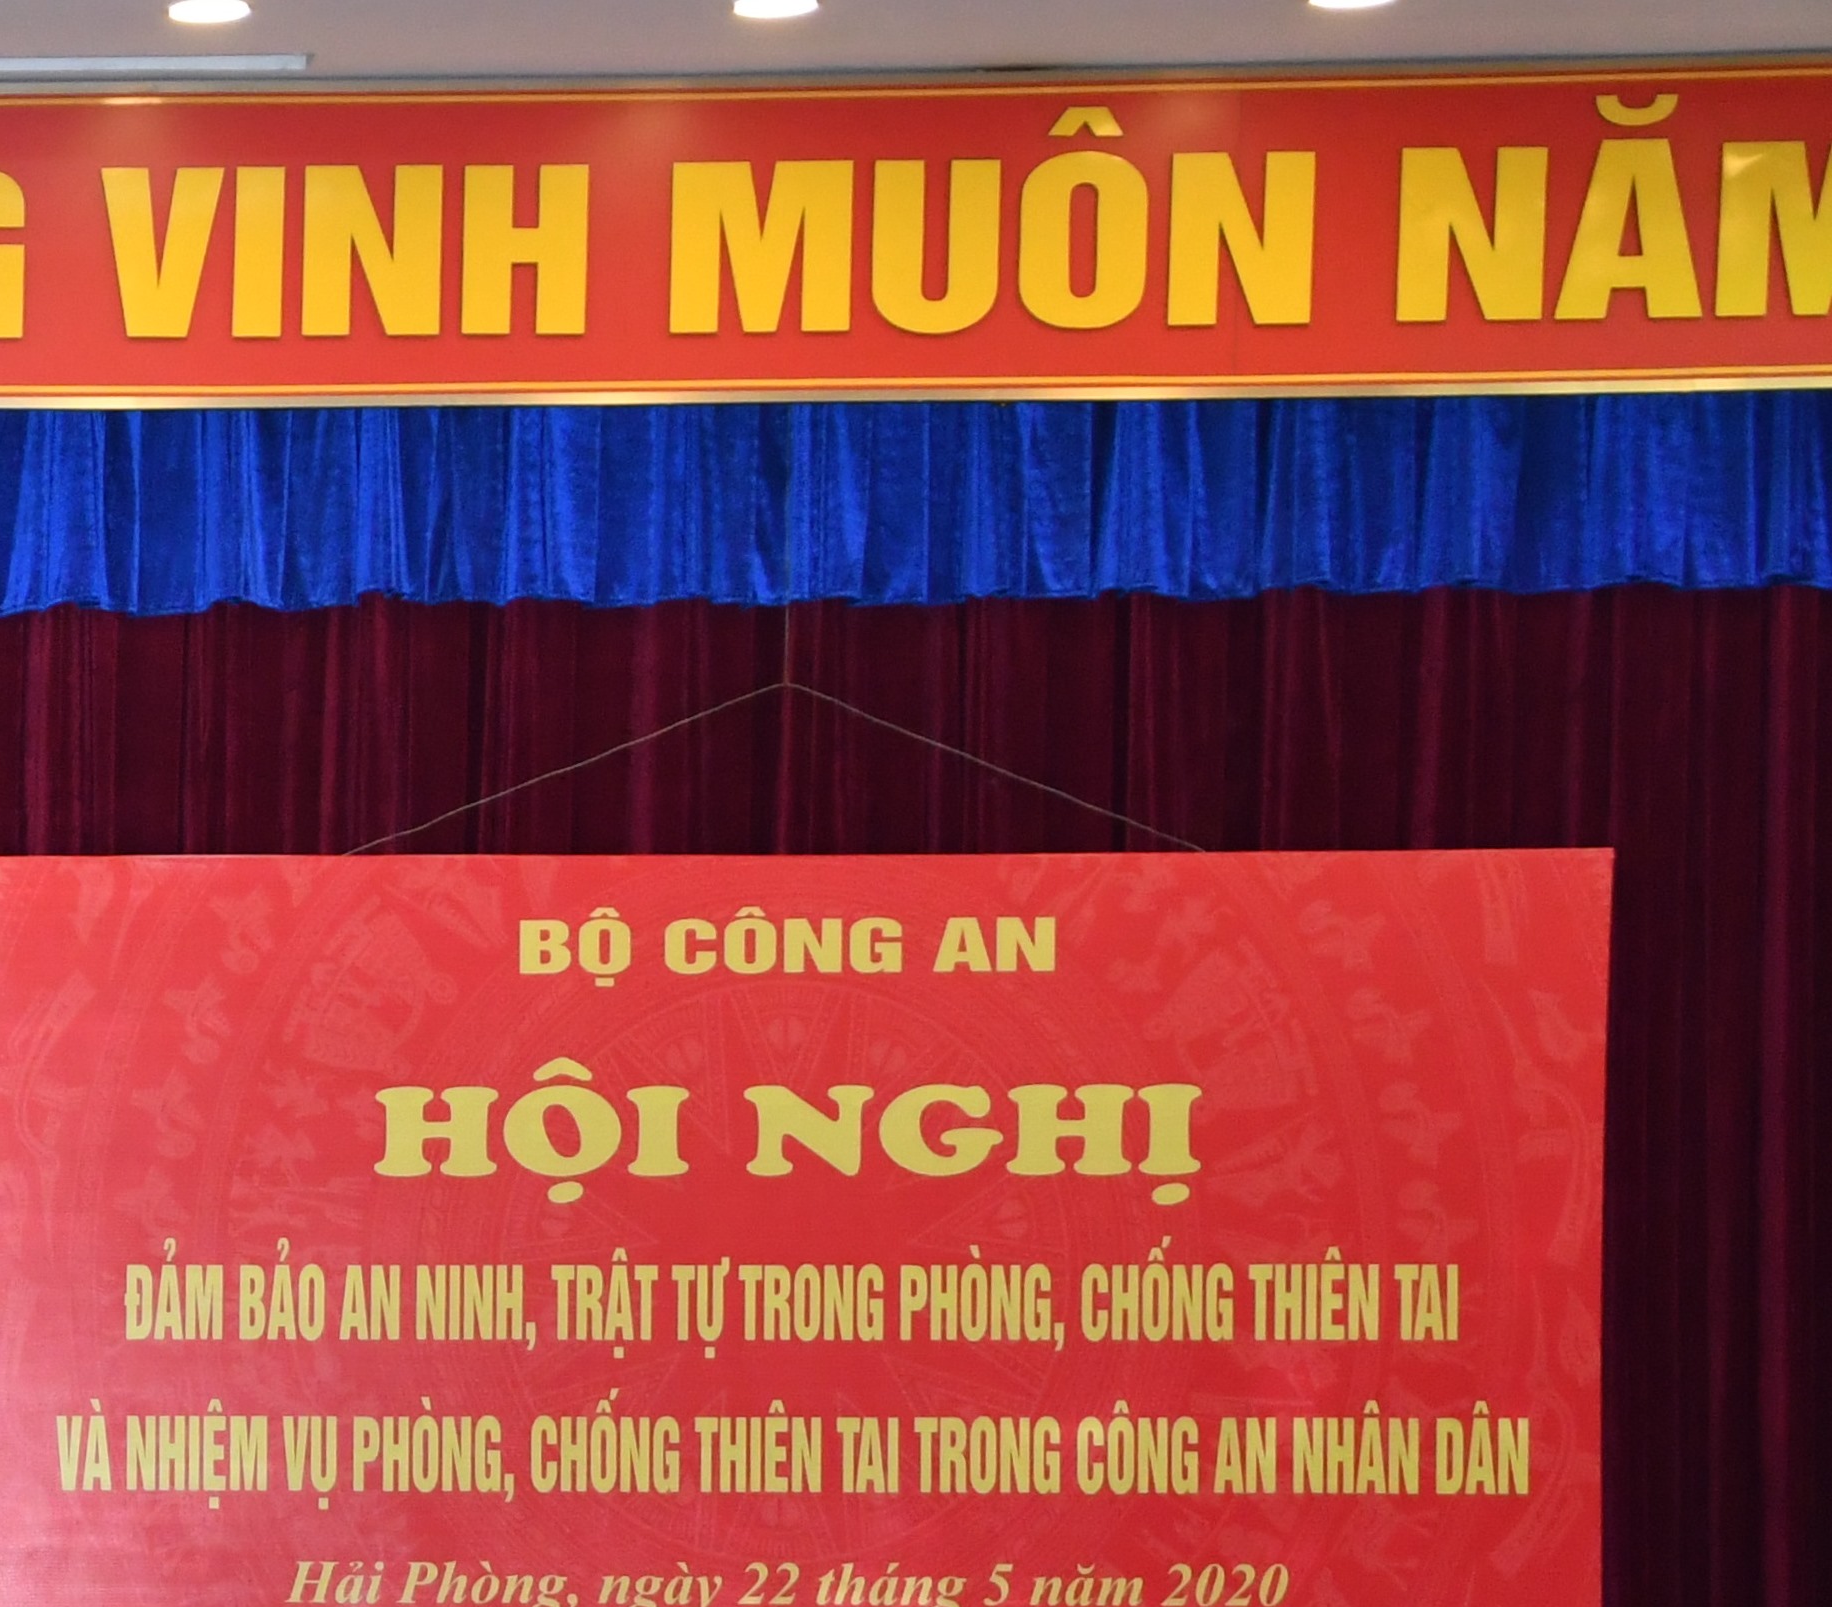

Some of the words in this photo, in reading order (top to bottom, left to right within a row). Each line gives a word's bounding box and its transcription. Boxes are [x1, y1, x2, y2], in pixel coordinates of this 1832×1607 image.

[102, 166, 589, 338] VINH
[669, 108, 1316, 333] MUÔN
[1395, 94, 1832, 322] NĂM
[519, 907, 633, 989] BỘ
[665, 907, 904, 977] CÔNG
[934, 917, 1058, 975] AN
[375, 1057, 692, 1207] HỘI
[743, 1084, 1205, 1207] NGHỊ
[125, 1238, 226, 1343] ĐẢM
[240, 1237, 328, 1343] BẢO
[341, 1264, 403, 1343] AN
[416, 1264, 538, 1350] NINH,
[551, 1247, 660, 1360] TRẬT
[672, 1256, 733, 1360] TỰ
[738, 1264, 887, 1344] TRONG
[900, 1245, 1066, 1352] PHÒNG,
[1081, 1235, 1235, 1343] CHỐNG
[1249, 1246, 1381, 1342] THIÊN
[1394, 1264, 1460, 1342] TAI
[57, 1400, 113, 1493] VÀ
[128, 1400, 270, 1511] NHIỆM
[283, 1416, 341, 1512] VỤ
[353, 1398, 516, 1502] PHÒNG,
[530, 1388, 682, 1496] CHỐNG
[695, 1400, 823, 1496] THIÊN
[837, 1416, 901, 1496] TAI
[915, 1416, 1063, 1497] TRONG
[1076, 1400, 1201, 1497] CÔNG
[1214, 1417, 1278, 1496] AN
[1293, 1401, 1421, 1497] NHÂN
[1436, 1401, 1531, 1497] DÂN
[290, 1561, 382, 1606] Hải
[741, 1562, 801, 1607] 22
